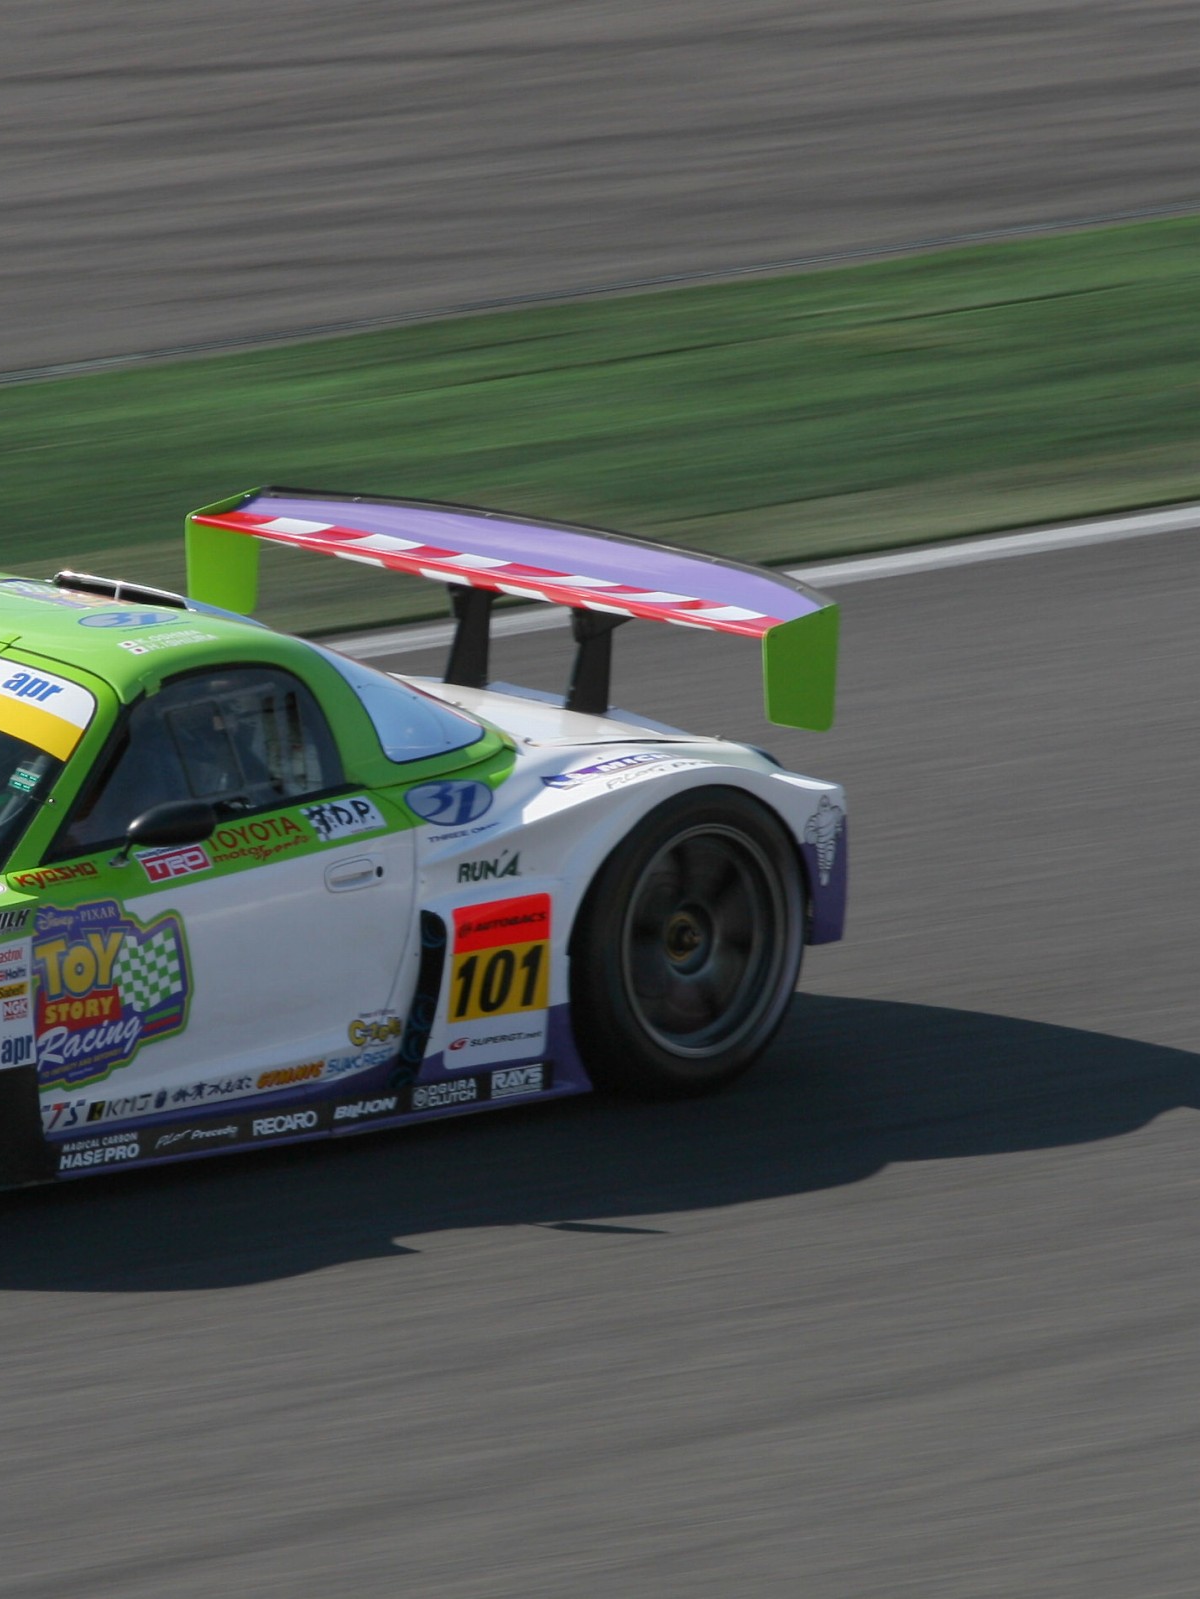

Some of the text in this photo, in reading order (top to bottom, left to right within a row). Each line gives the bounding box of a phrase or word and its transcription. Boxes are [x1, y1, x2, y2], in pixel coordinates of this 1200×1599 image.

[2, 672, 64, 702] apr
[208, 816, 302, 852] TOYOTA
[13, 862, 97, 890] KYOSHO
[38, 906, 116, 931] Disney PIXAR
[34, 931, 124, 997] TOY
[455, 944, 544, 1018] 101
[3, 999, 28, 1016] NGK
[44, 996, 115, 1024] STORY
[1, 1034, 33, 1065] apr
[37, 1015, 142, 1072] Racing
[469, 1029, 543, 1047] SUPERGT.net
[428, 1077, 477, 1096] OGURA
[491, 1066, 543, 1090] RAYS
[429, 1088, 478, 1107] CLUTCH
[252, 1110, 318, 1136] RECARO
[62, 1131, 138, 1152] MAGICAL CARBON
